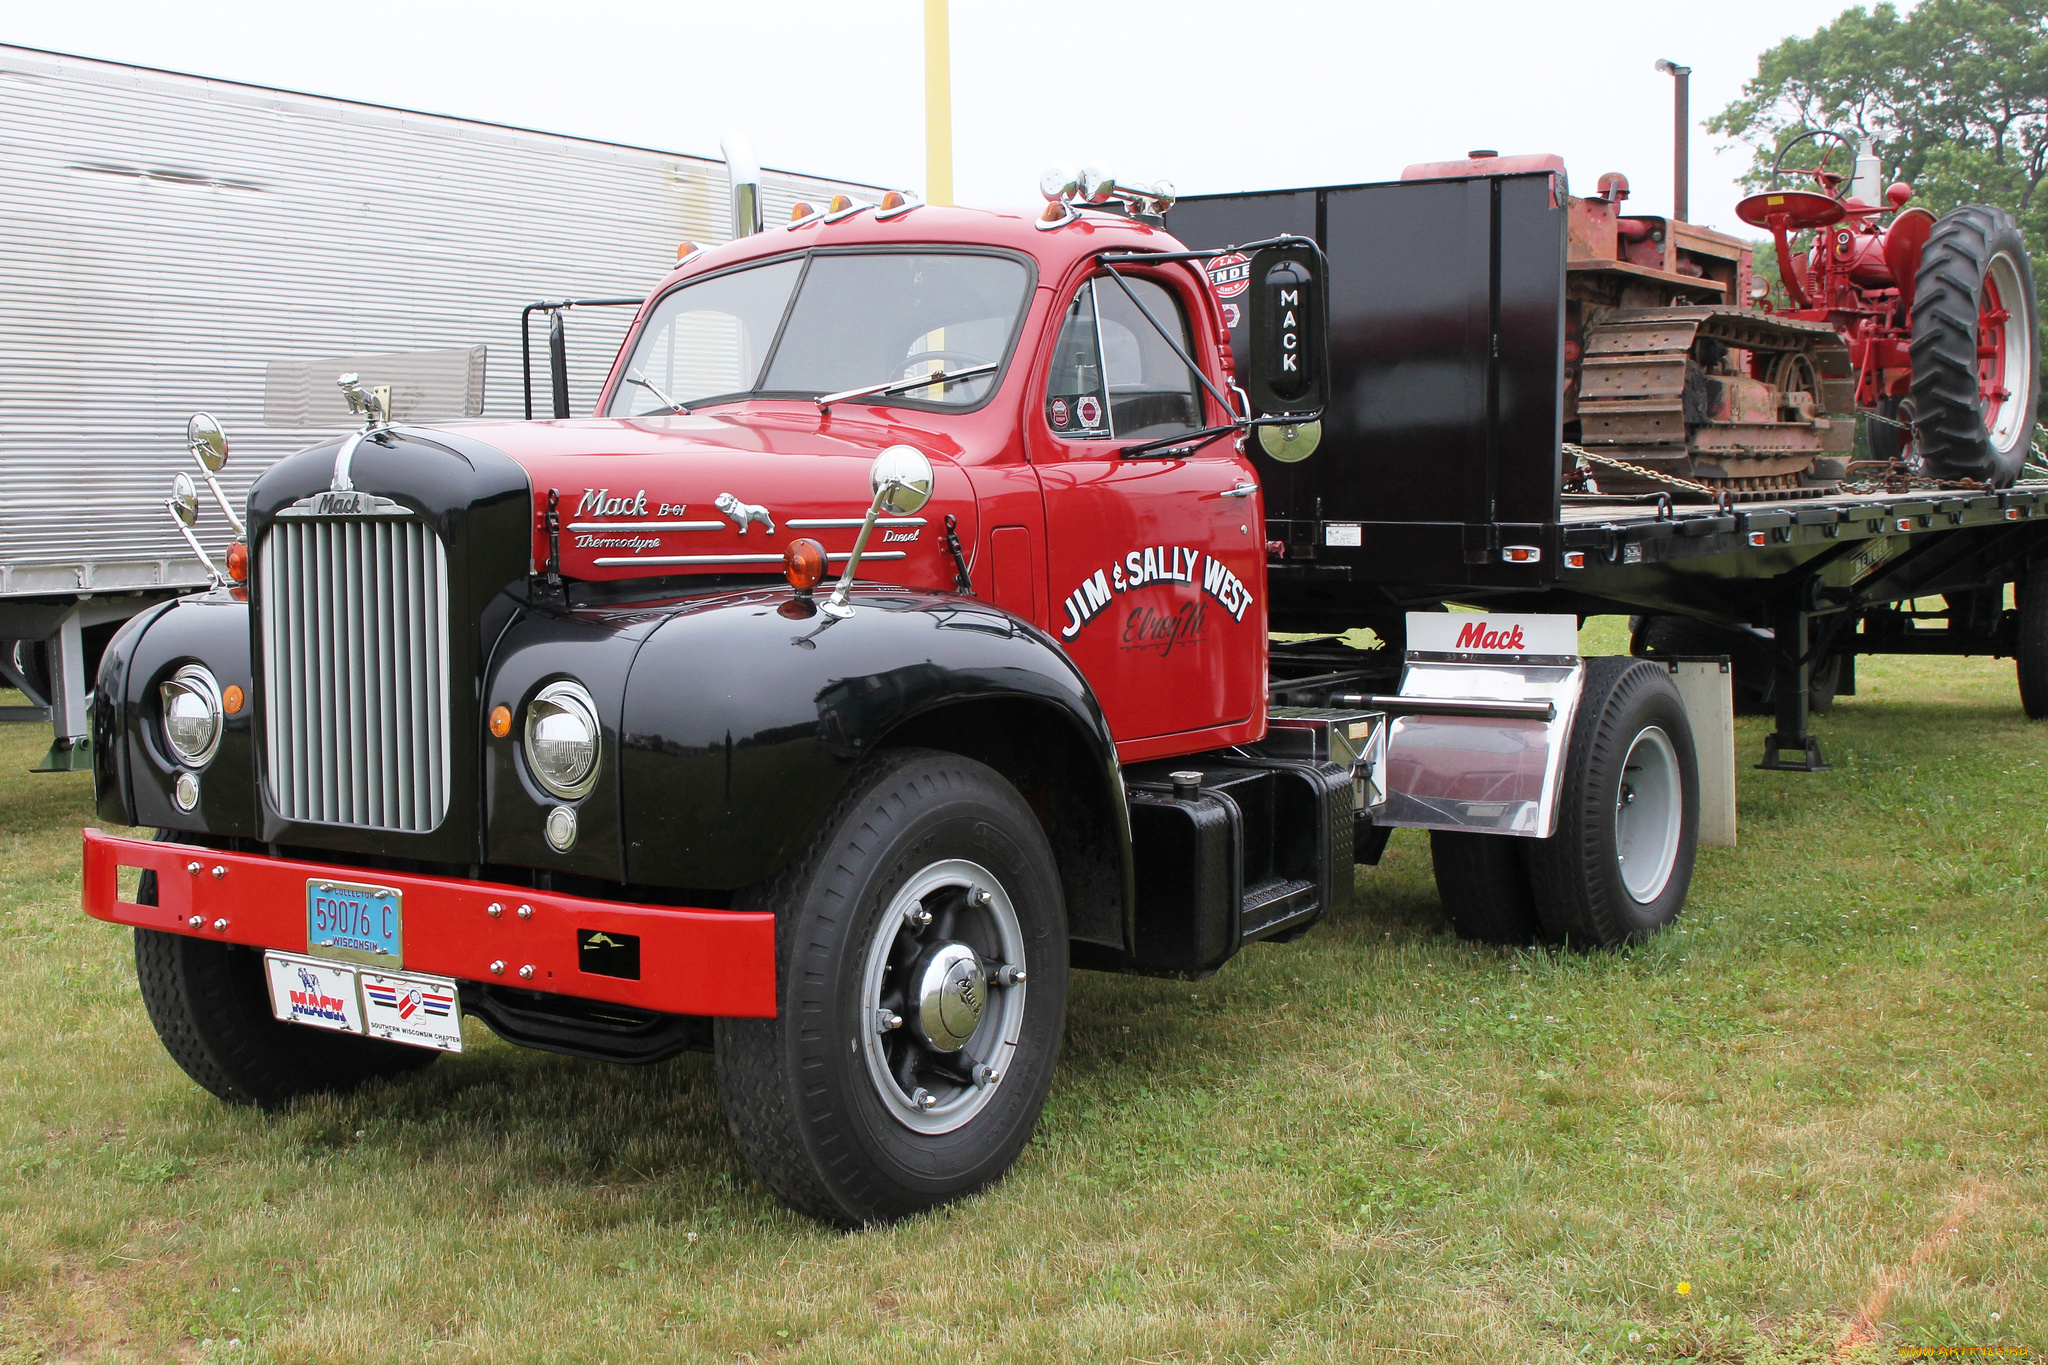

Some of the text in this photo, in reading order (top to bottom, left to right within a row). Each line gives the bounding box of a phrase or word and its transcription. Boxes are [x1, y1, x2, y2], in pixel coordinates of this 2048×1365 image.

[1208, 264, 1250, 284] ENDE
[1280, 289, 1299, 372] MACK
[317, 493, 362, 515] Mack
[574, 487, 649, 518] Mack
[574, 534, 661, 554] Thermodyne
[882, 528, 920, 543] Diesel
[1855, 539, 1888, 574] BENDER
[1061, 545, 1254, 640] JIM & SALLY WEST
[1455, 621, 1526, 650] Mack
[315, 897, 393, 939] 59076 C
[332, 935, 378, 951] WISCONSIN
[290, 989, 347, 1022] MACK
[370, 1021, 461, 1043] SOUTHERN WISCONSIN CHAPTER
